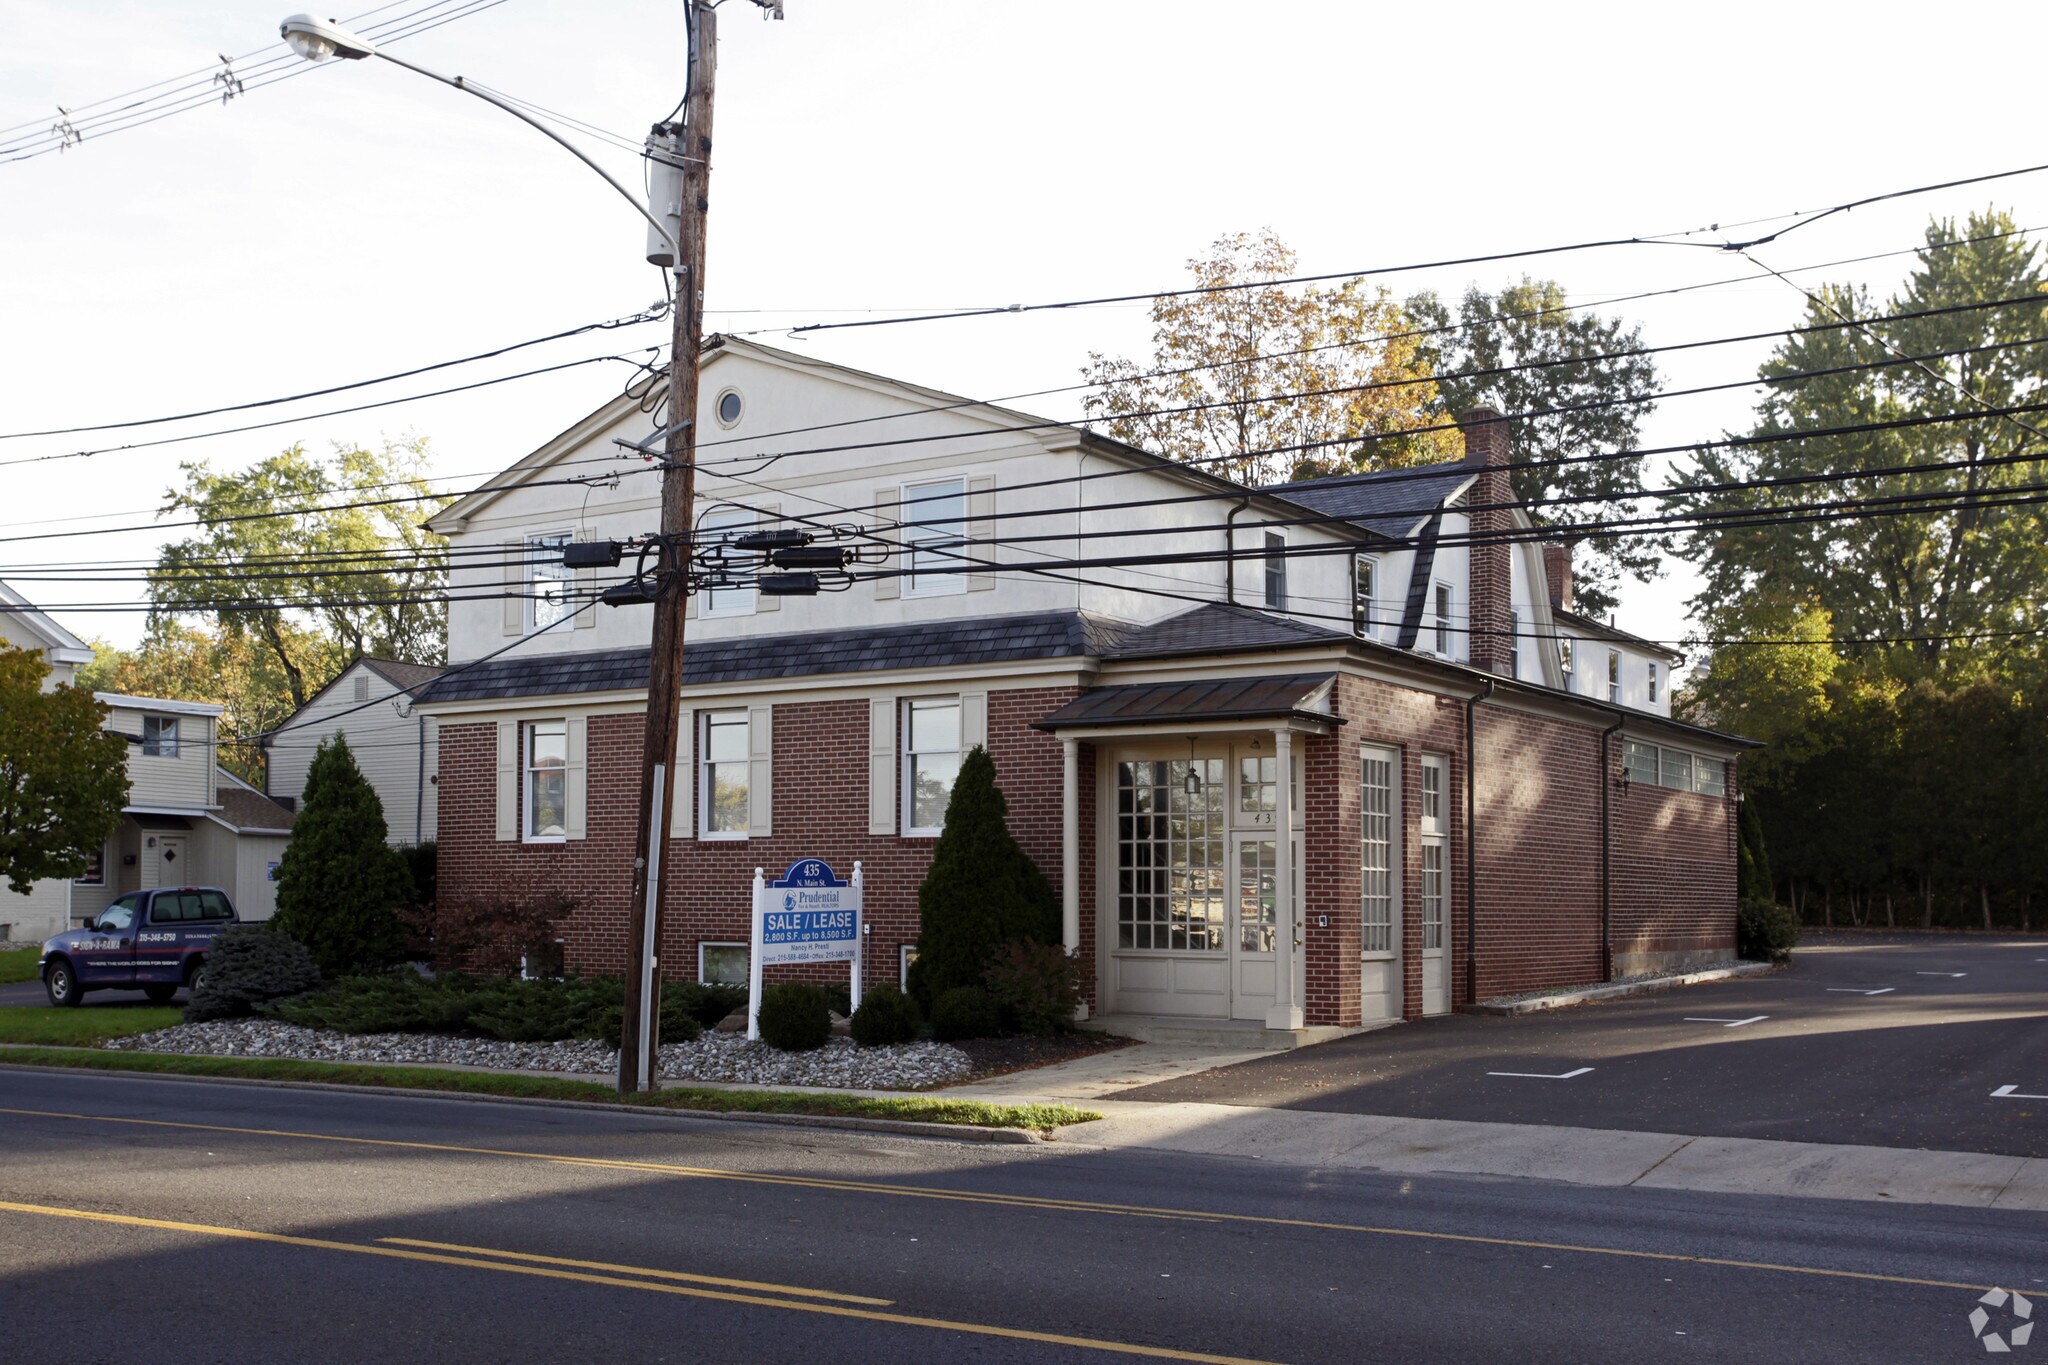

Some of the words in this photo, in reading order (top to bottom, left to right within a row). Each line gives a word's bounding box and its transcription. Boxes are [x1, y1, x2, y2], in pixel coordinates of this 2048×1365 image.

[1254, 813, 1276, 824] 43
[804, 864, 820, 877] 435
[804, 879, 818, 887] Main
[799, 890, 839, 903] Prudential
[768, 914, 801, 931] SALE
[804, 913, 810, 929] /
[813, 912, 852, 929] LEASE
[139, 933, 176, 942] 215-348-5750
[764, 932, 785, 943] 2,800
[786, 931, 800, 941] S.F.
[801, 933, 810, 942] up
[812, 932, 819, 940] to
[821, 930, 839, 941] 8,500
[841, 929, 855, 938] S.F.
[790, 944, 807, 952] Nancy
